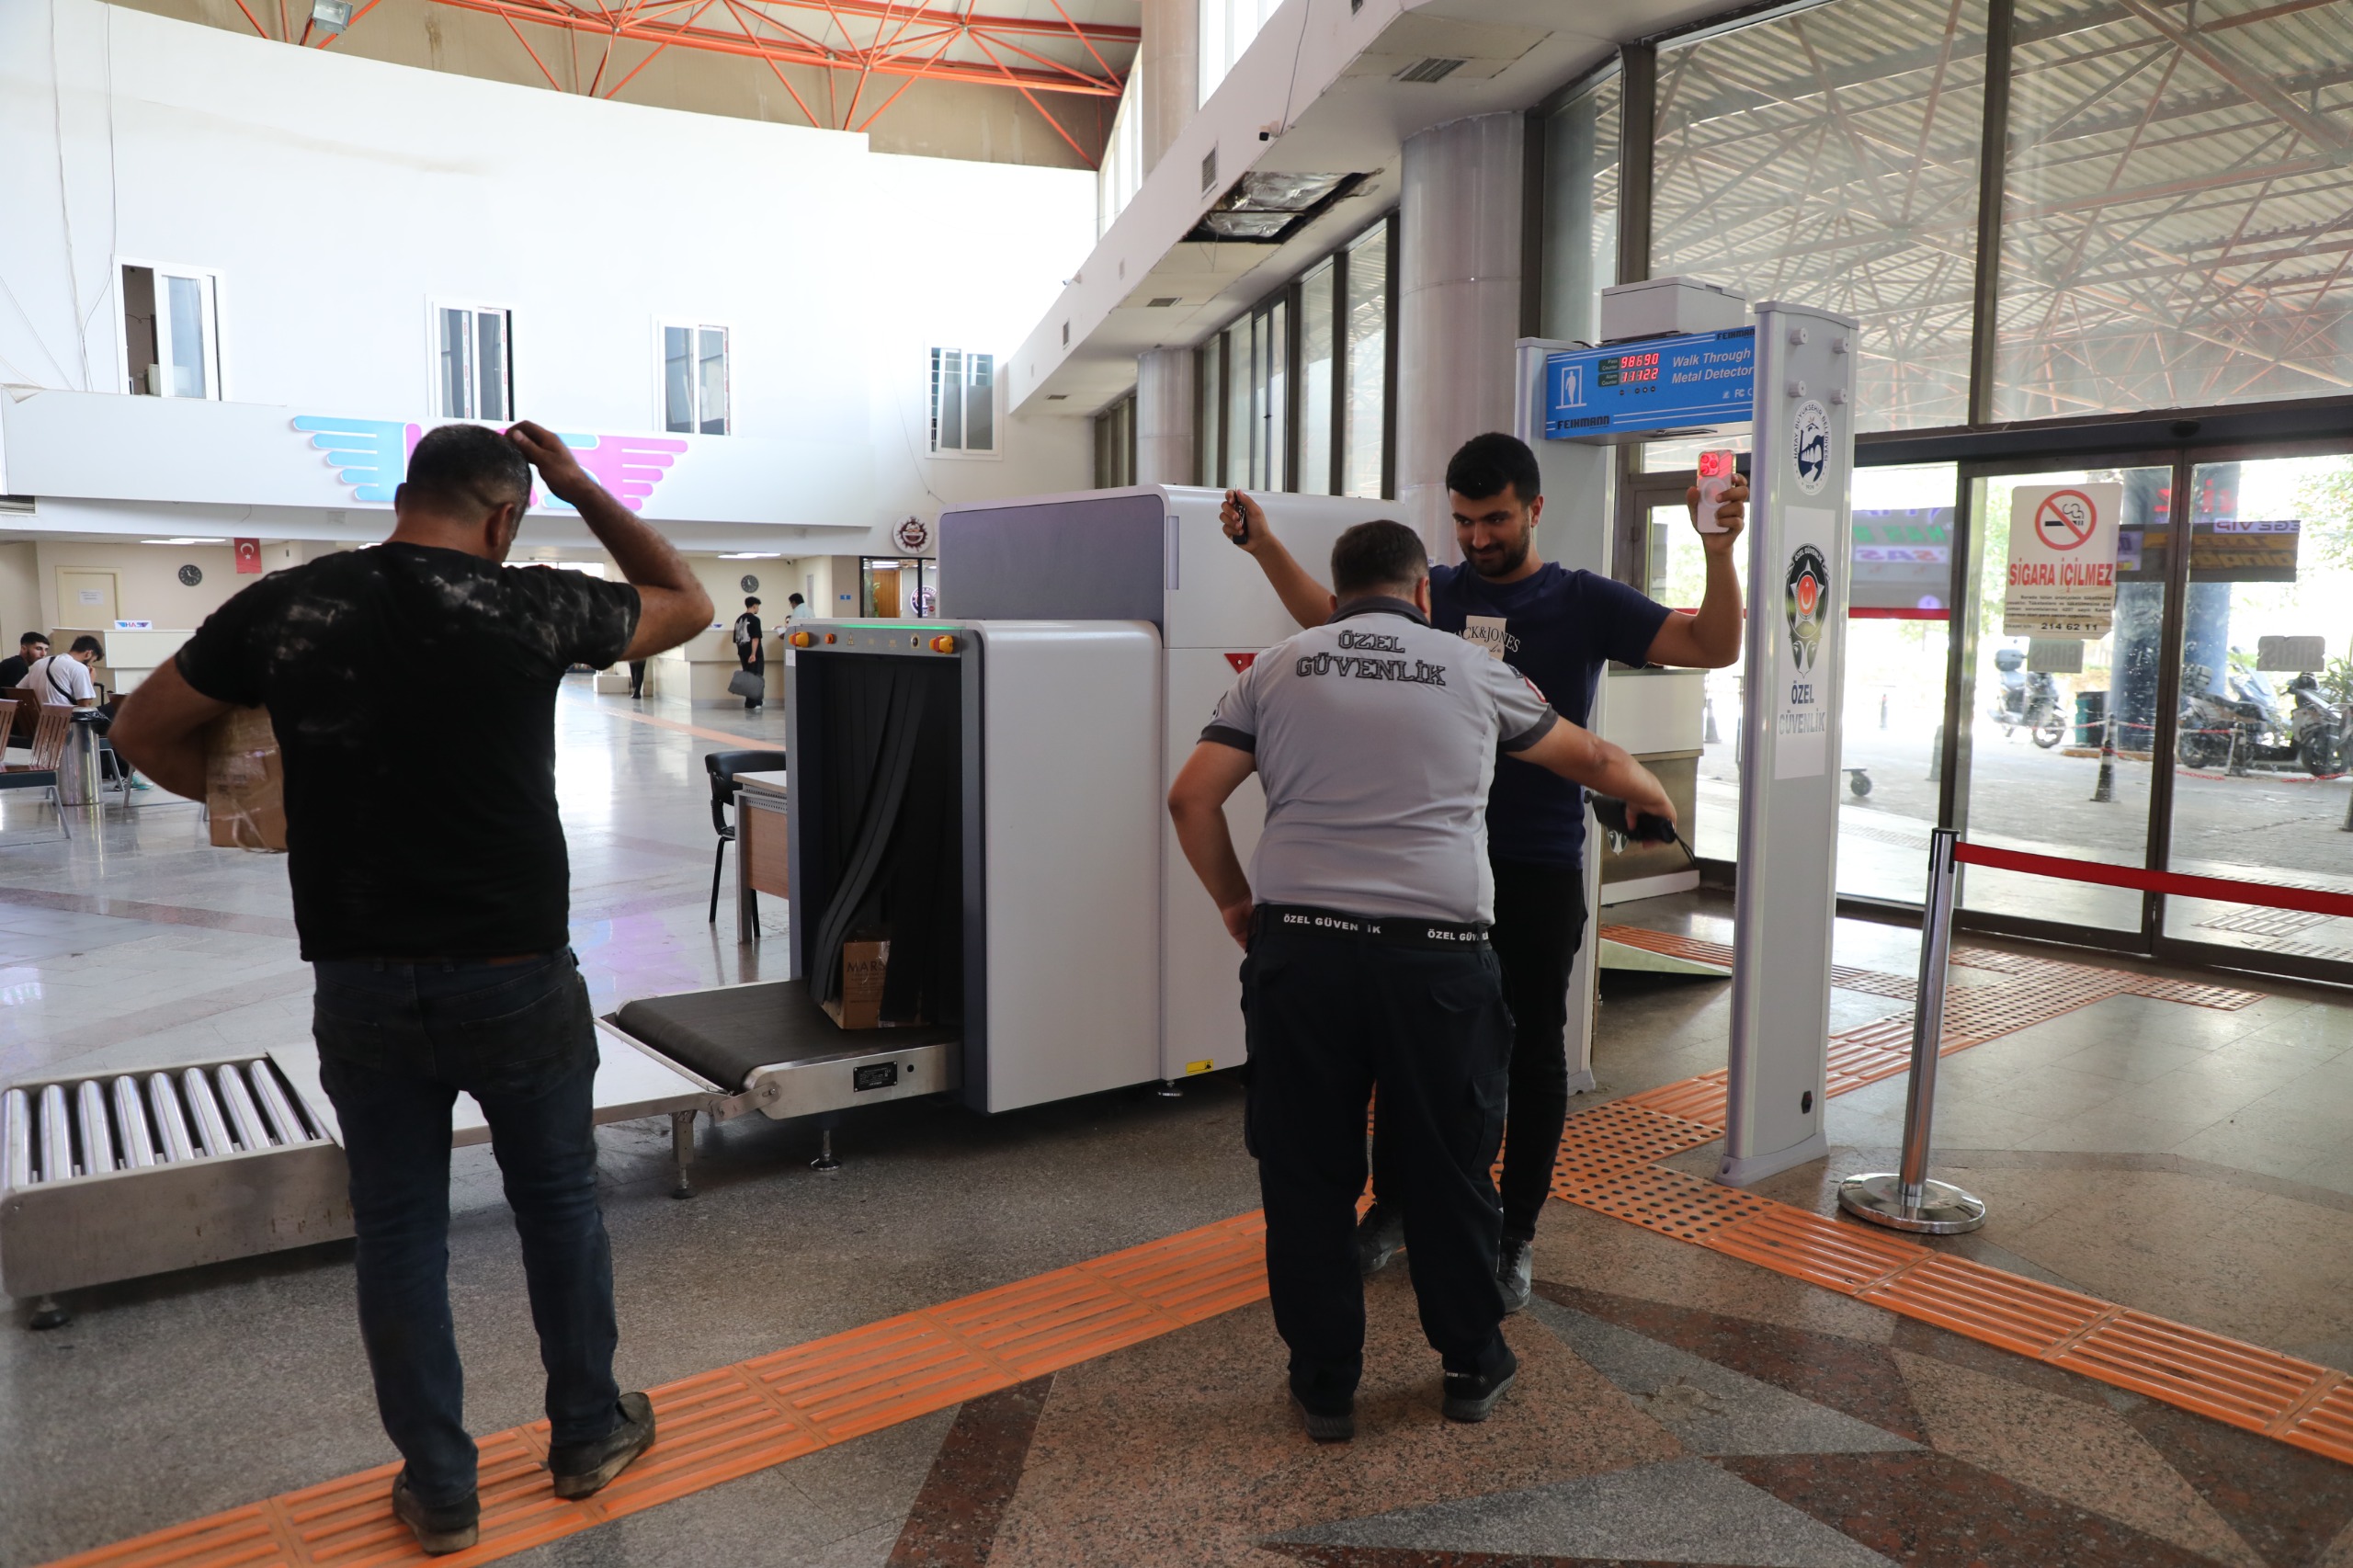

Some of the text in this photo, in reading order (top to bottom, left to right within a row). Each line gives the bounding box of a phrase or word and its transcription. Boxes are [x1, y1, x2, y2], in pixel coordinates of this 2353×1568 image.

[1620, 353, 1659, 369] 98690
[1673, 347, 1751, 368] Walk Through
[1622, 368, 1658, 383] 11122
[1672, 366, 1755, 384] Metal Detector
[2009, 557, 2113, 593] SİGARA İÇİLMEZ
[2040, 622, 2062, 631] 214
[1338, 630, 1405, 653] ÖZEL
[1454, 626, 1521, 653] ACK&JONES
[1297, 652, 1446, 686] GÜVENLİK
[1791, 680, 1814, 704] ÖZEL
[1779, 708, 1825, 734] GÜVENLİK
[1283, 914, 1381, 934] ÖZEL GÜVENİK
[1427, 928, 1456, 940] ÖZEL
